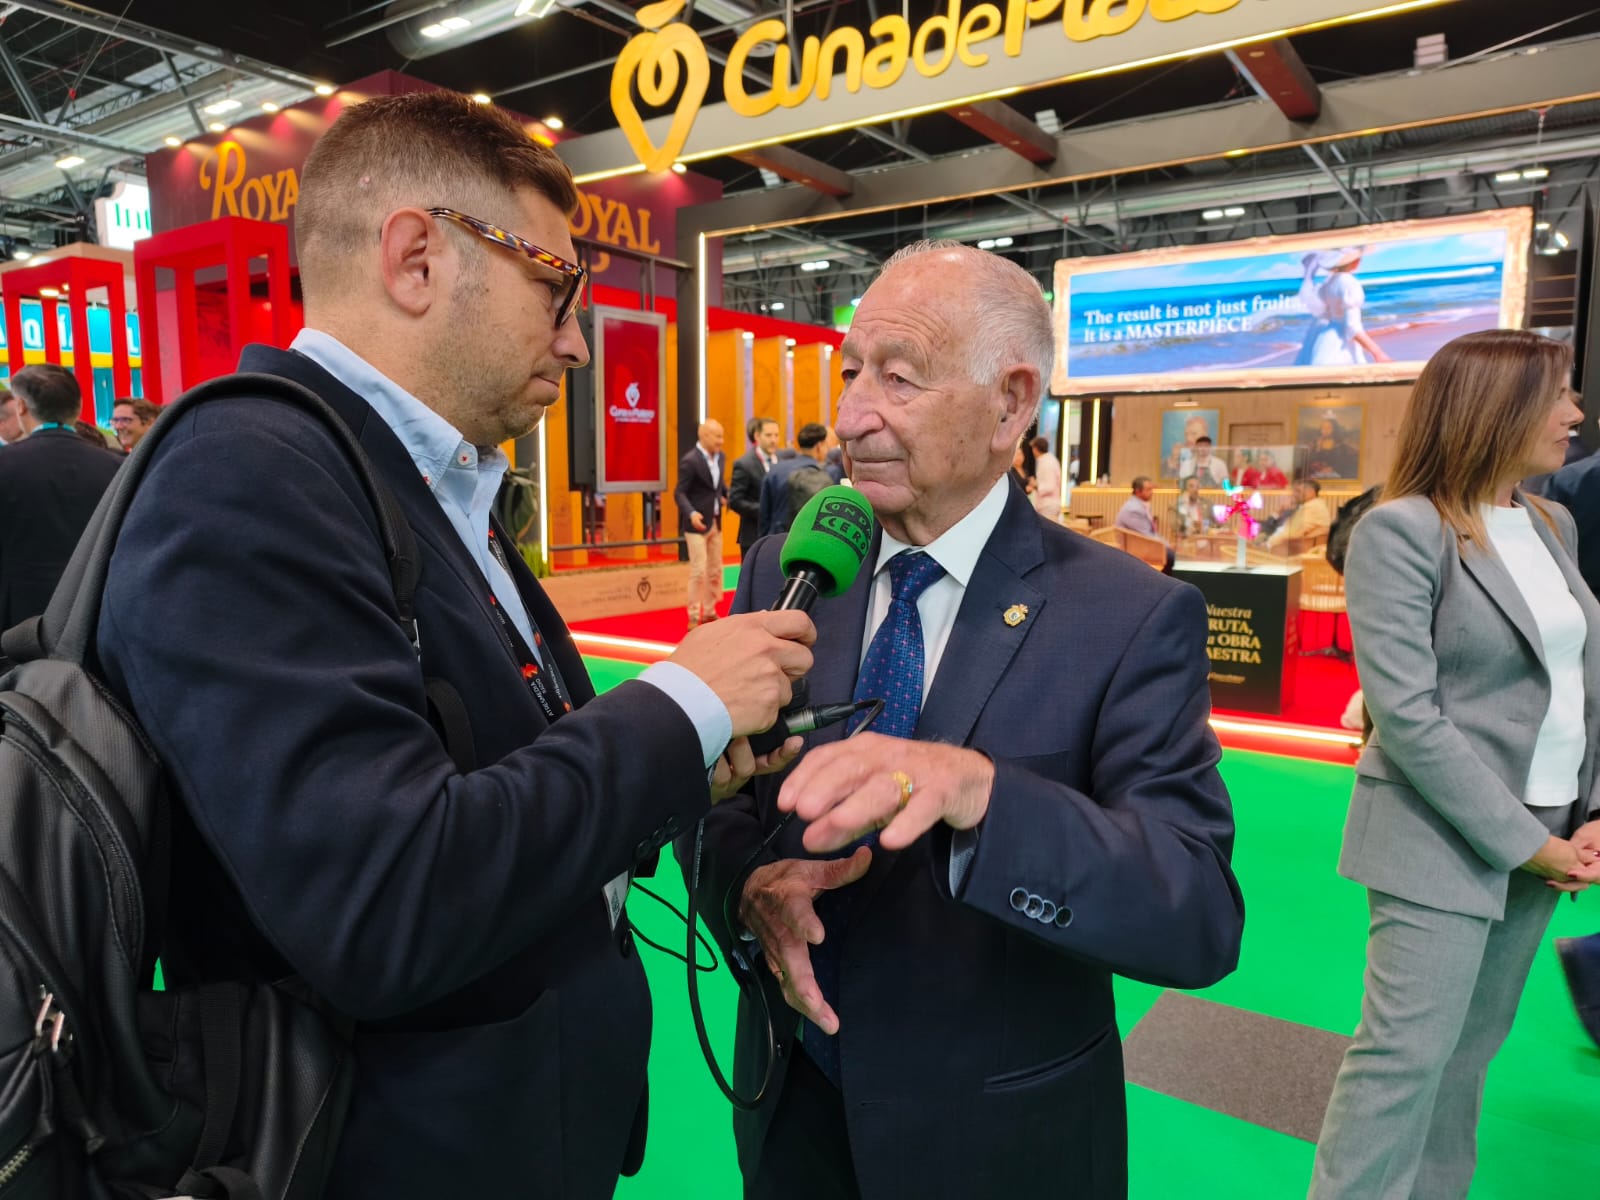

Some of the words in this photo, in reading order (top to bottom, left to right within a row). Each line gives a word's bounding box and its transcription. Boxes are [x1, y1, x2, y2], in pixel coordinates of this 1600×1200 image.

[199, 140, 300, 222] ROYA
[568, 190, 660, 254] OYAL
[1084, 308, 1114, 325] The
[1117, 304, 1162, 322] result
[1166, 303, 1180, 319] is
[1183, 302, 1212, 318] not
[1215, 299, 1247, 318] just
[1099, 327, 1112, 342] is
[1113, 329, 1123, 341] a
[1126, 316, 1253, 340] MASTERPIECE
[828, 517, 867, 550] CERO
[1208, 617, 1254, 636] RUTA,
[1217, 633, 1261, 650] OBRA
[1206, 647, 1261, 665] AESTRA
